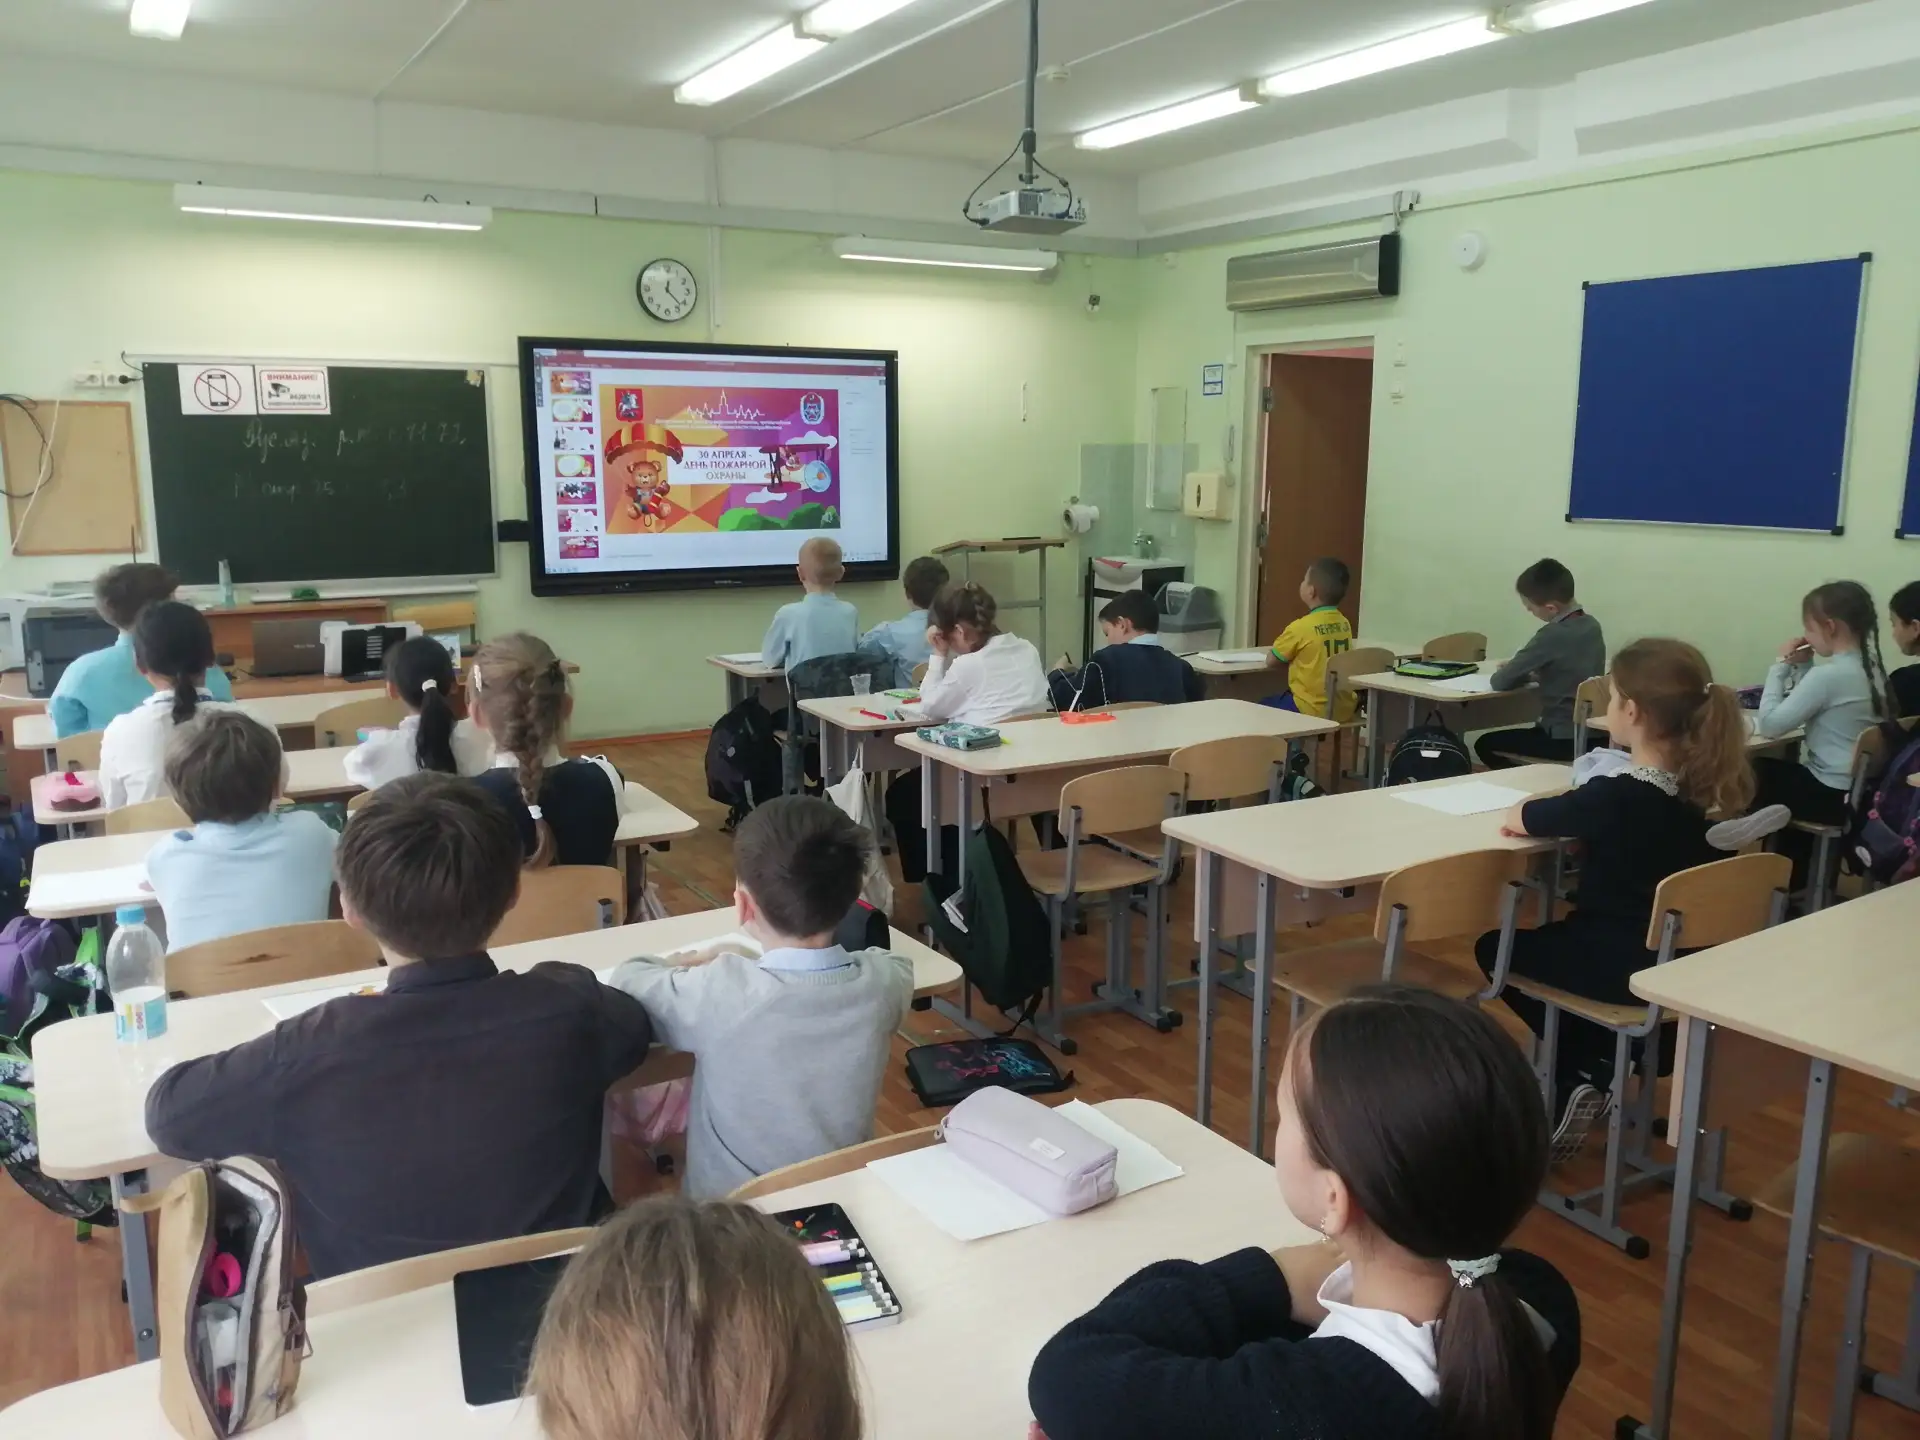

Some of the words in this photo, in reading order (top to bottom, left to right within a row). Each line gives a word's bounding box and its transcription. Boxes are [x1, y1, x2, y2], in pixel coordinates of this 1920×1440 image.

[699, 450, 709, 458] 30
[711, 450, 747, 459] АПРЕЛЯ
[684, 460, 709, 470] ДЕНЬ
[710, 459, 767, 469] ПОЖАРНОЙ
[705, 471, 747, 481] ОХРАНЫ
